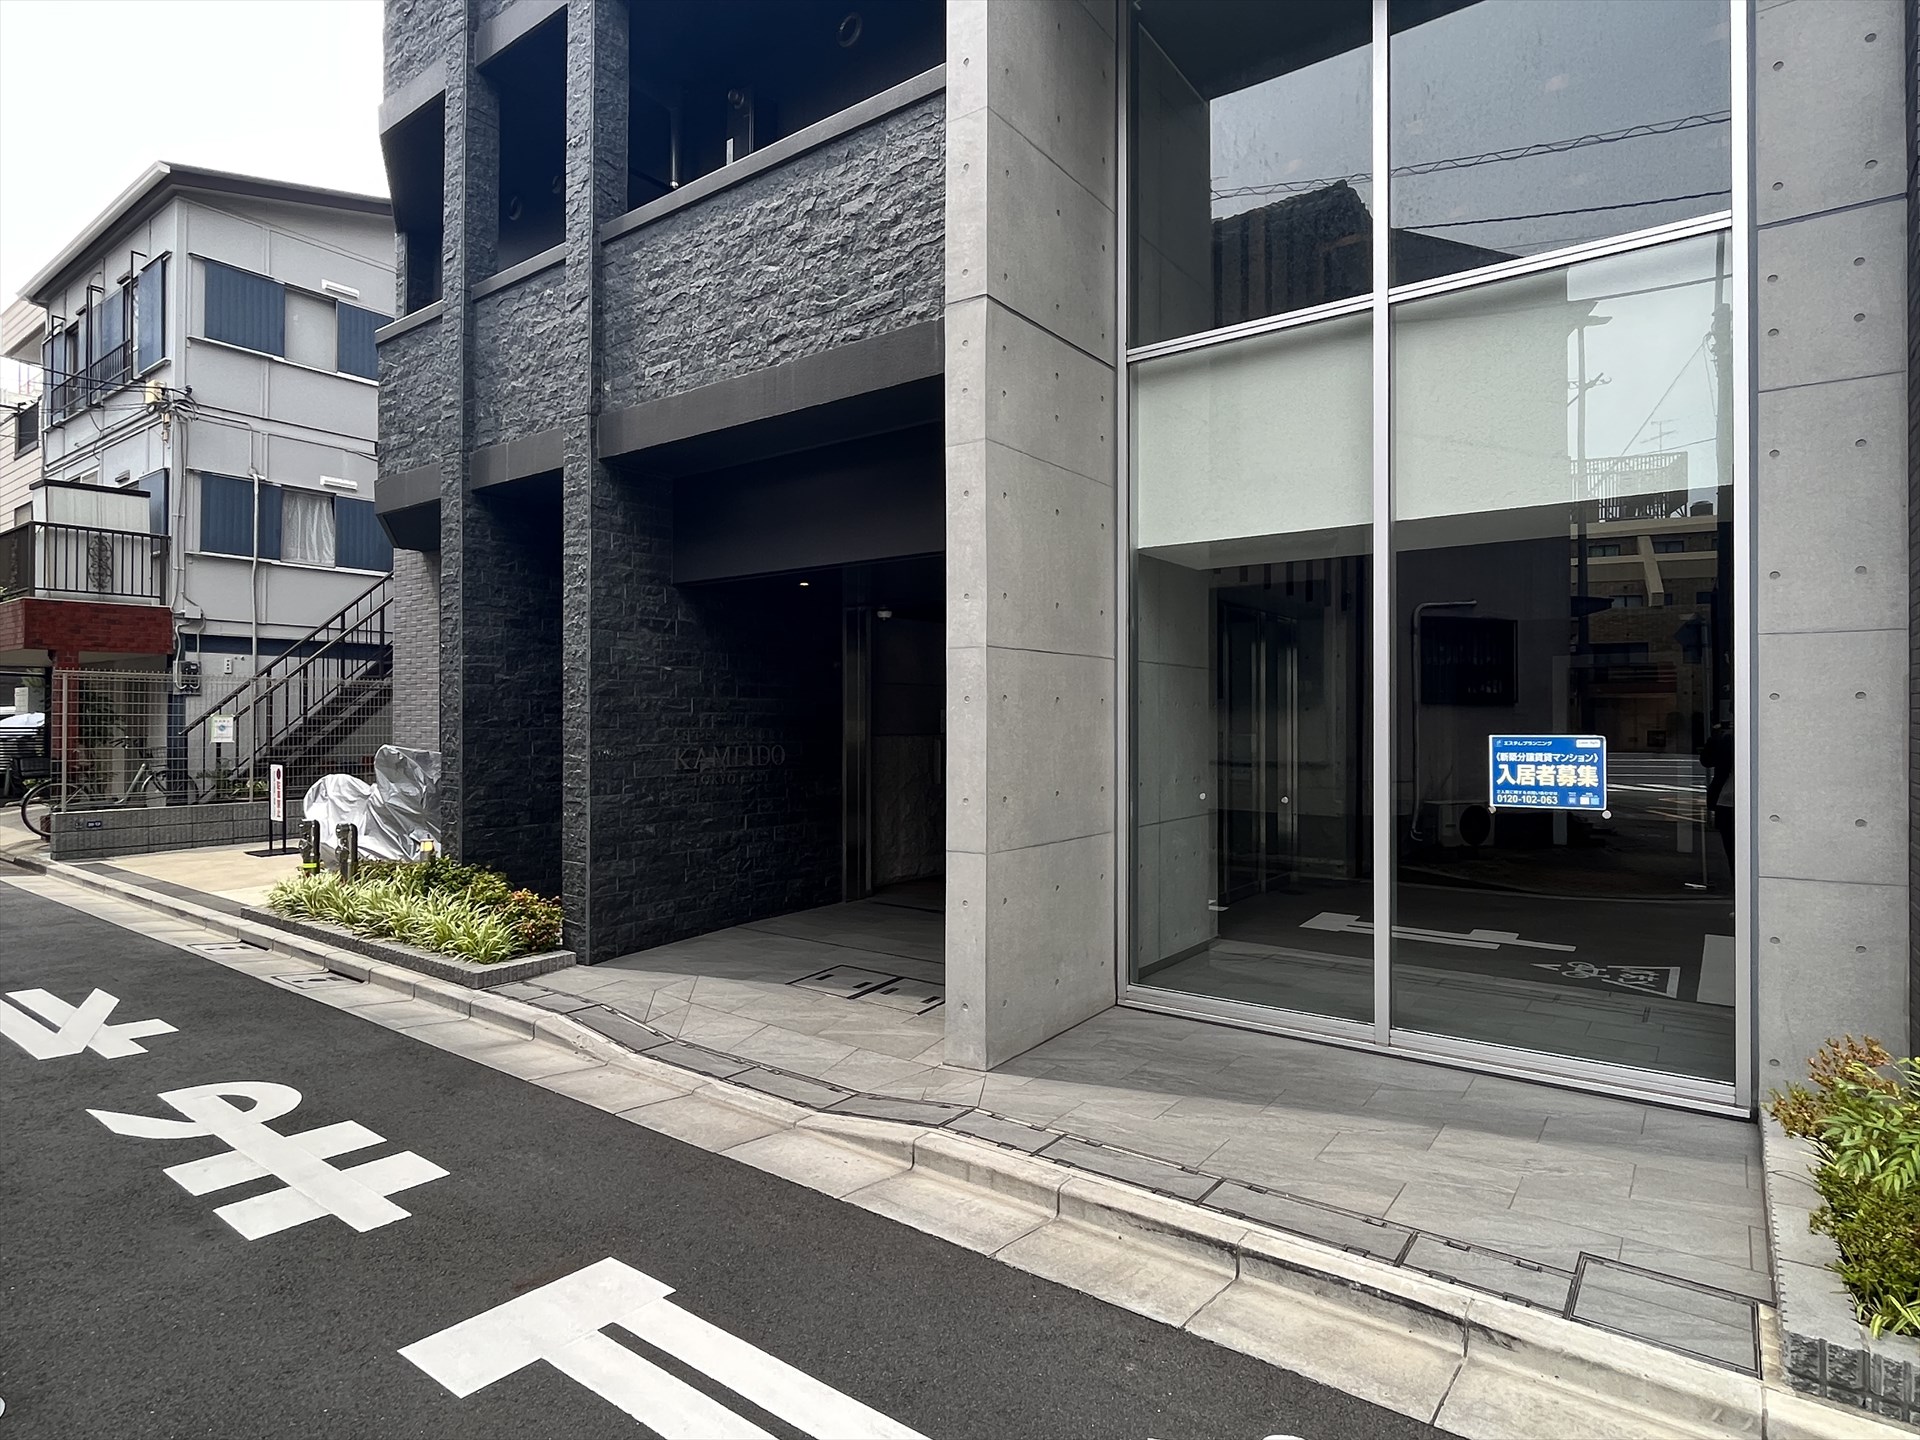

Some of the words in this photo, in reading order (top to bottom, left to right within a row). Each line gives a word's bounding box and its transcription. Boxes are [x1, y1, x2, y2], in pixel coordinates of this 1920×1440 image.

[673, 744, 786, 770] KAMEIDO
[693, 773, 736, 787] TOKYO
[1496, 764, 1599, 787] 入居者募集
[1496, 794, 1558, 805] 0120-102-063
